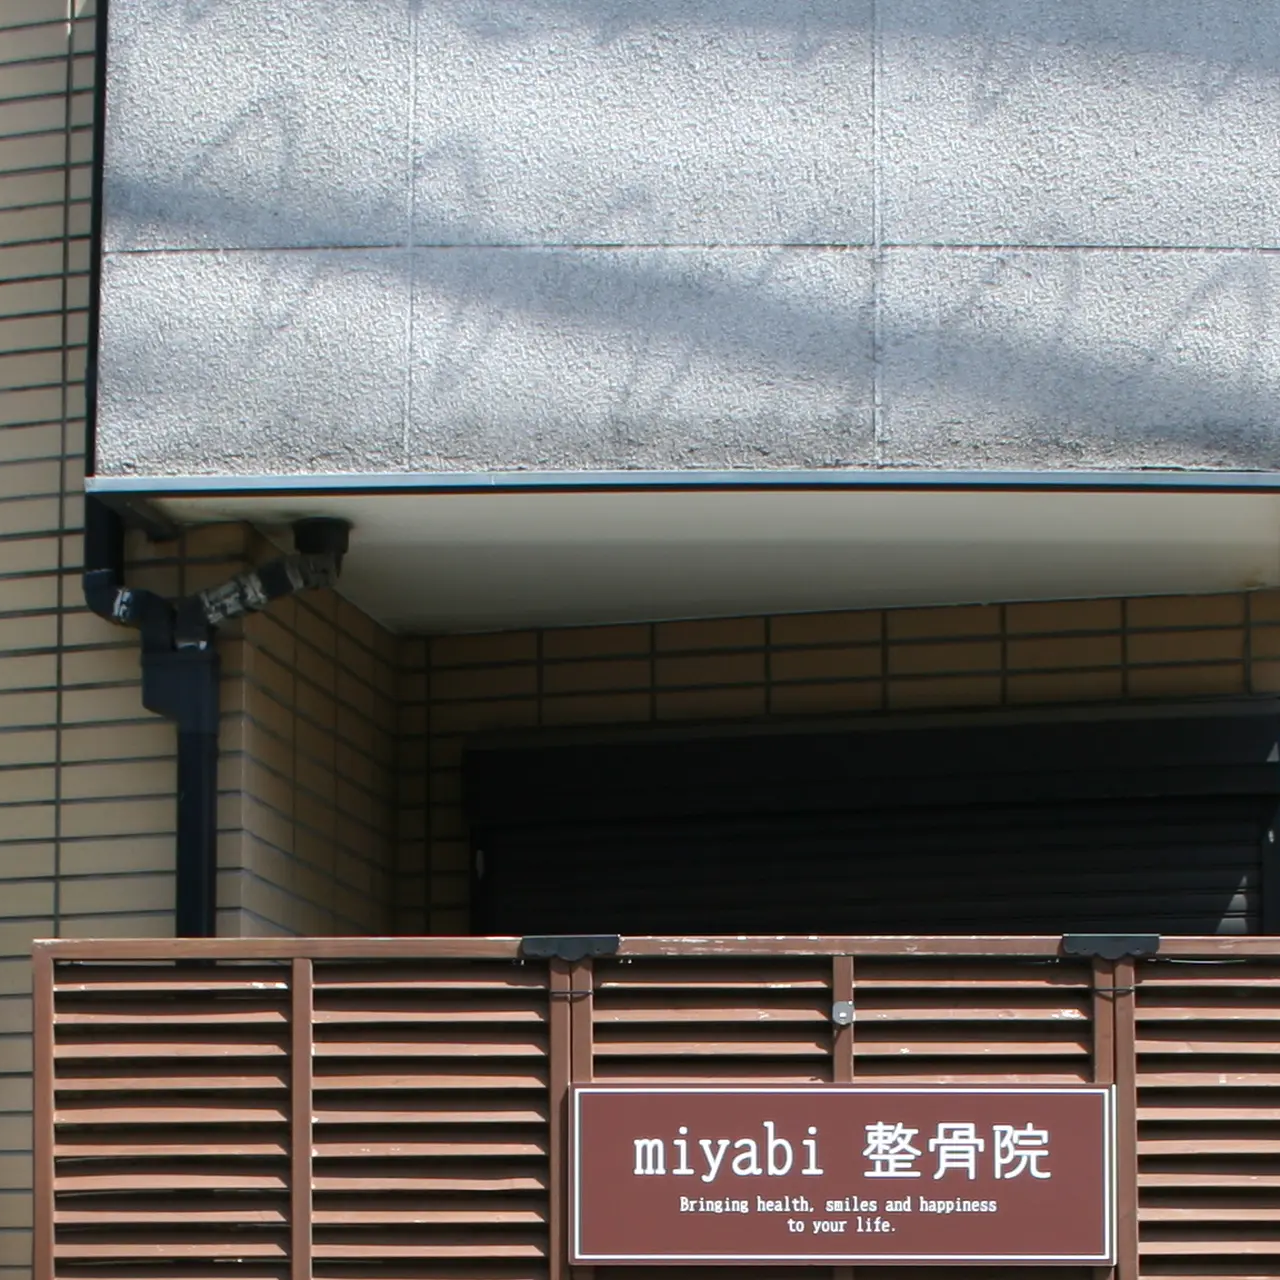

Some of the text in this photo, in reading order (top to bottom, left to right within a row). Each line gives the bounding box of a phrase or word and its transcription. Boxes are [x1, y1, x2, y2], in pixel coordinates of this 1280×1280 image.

[633, 1121, 1052, 1183] miyabi 整骨院
[679, 1196, 749, 1217] Bringing
[825, 1196, 879, 1214] smiles
[885, 1196, 912, 1214] and
[919, 1196, 998, 1217] happiness
[787, 1217, 897, 1235] to your life.
